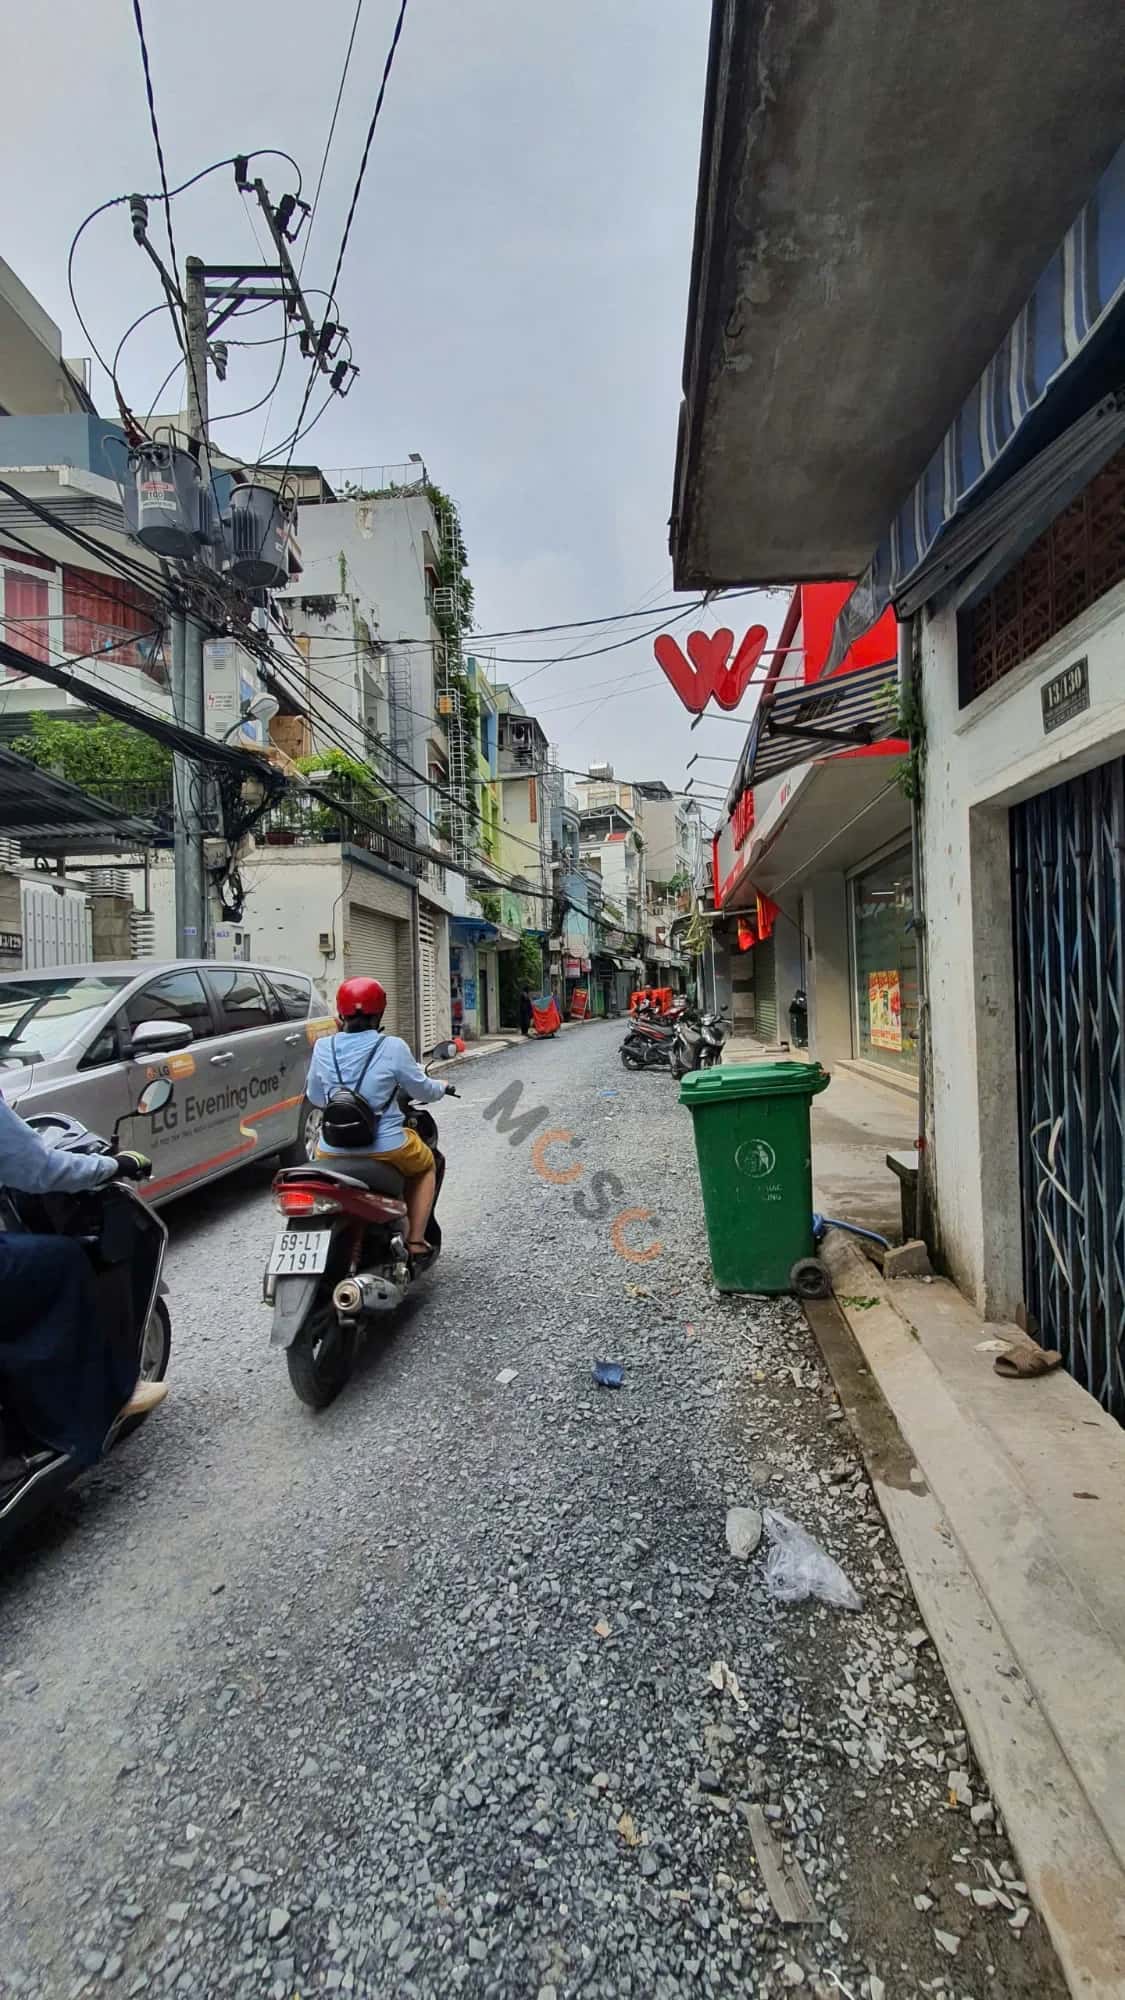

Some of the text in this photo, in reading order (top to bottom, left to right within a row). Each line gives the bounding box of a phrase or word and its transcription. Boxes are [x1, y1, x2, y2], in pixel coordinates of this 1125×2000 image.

[654, 624, 768, 714] W
[1048, 666, 1081, 707] 13/130
[159, 1065, 170, 1077] LG
[151, 1101, 178, 1135] LG
[275, 1252, 318, 1273] 7191
